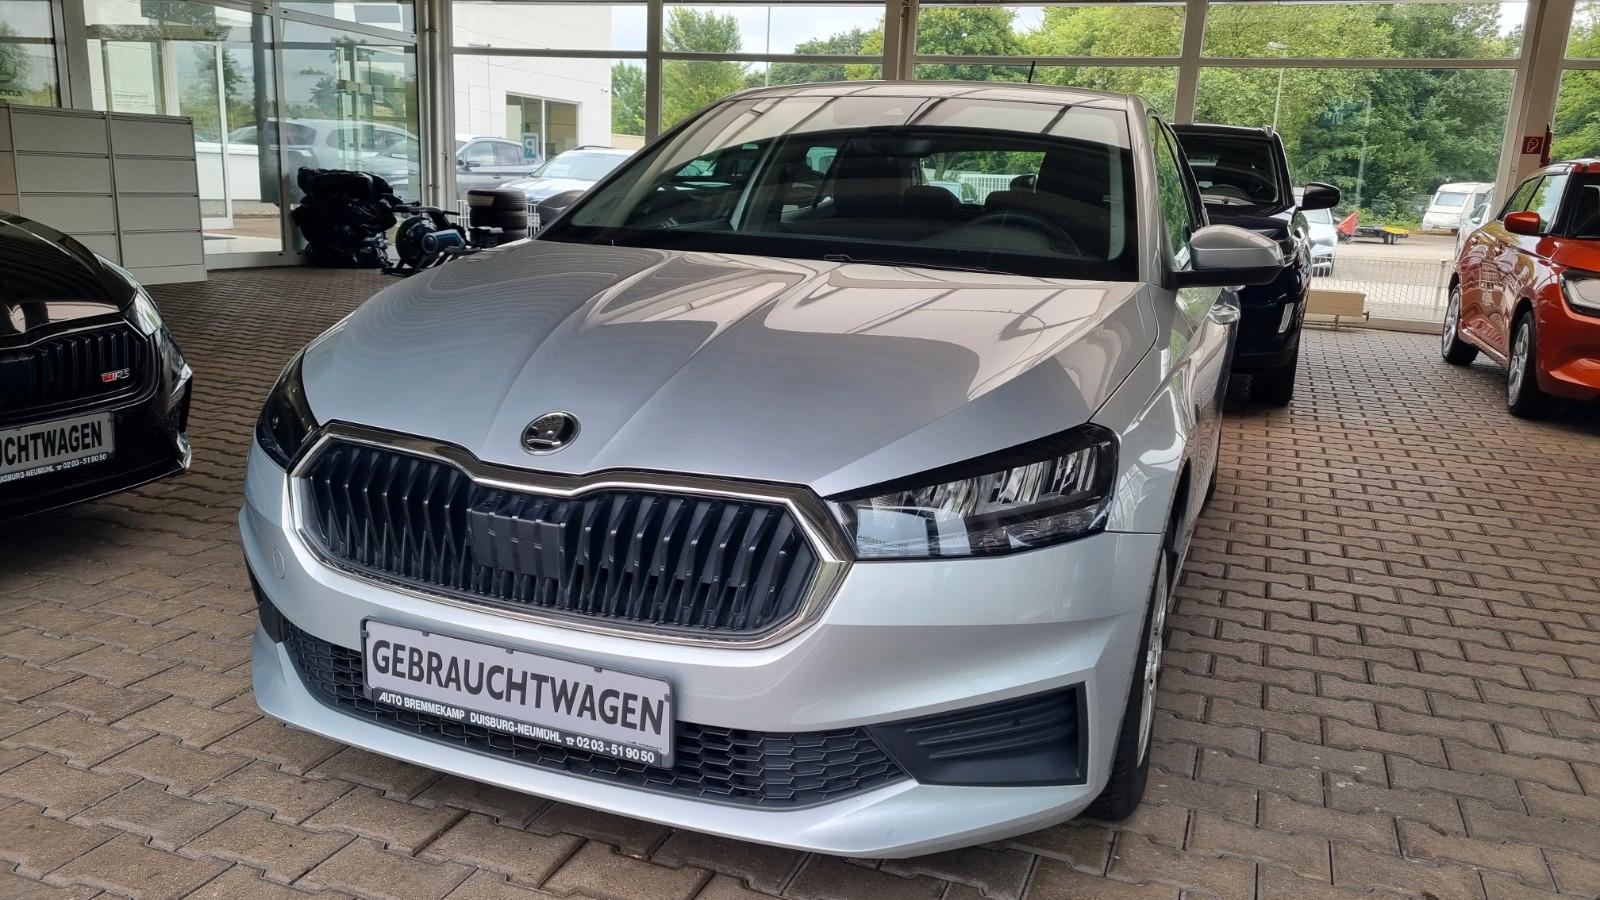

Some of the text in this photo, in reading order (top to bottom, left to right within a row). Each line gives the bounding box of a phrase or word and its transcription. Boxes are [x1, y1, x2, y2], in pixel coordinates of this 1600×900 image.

[0, 420, 103, 468] CHTWAGEN
[371, 639, 664, 736] GEBRAUCHTWAGEN
[379, 691, 403, 706] AUTO
[403, 697, 465, 720] BREMMEKAMP
[470, 712, 562, 743] DUISBURG-NEUMÜHL
